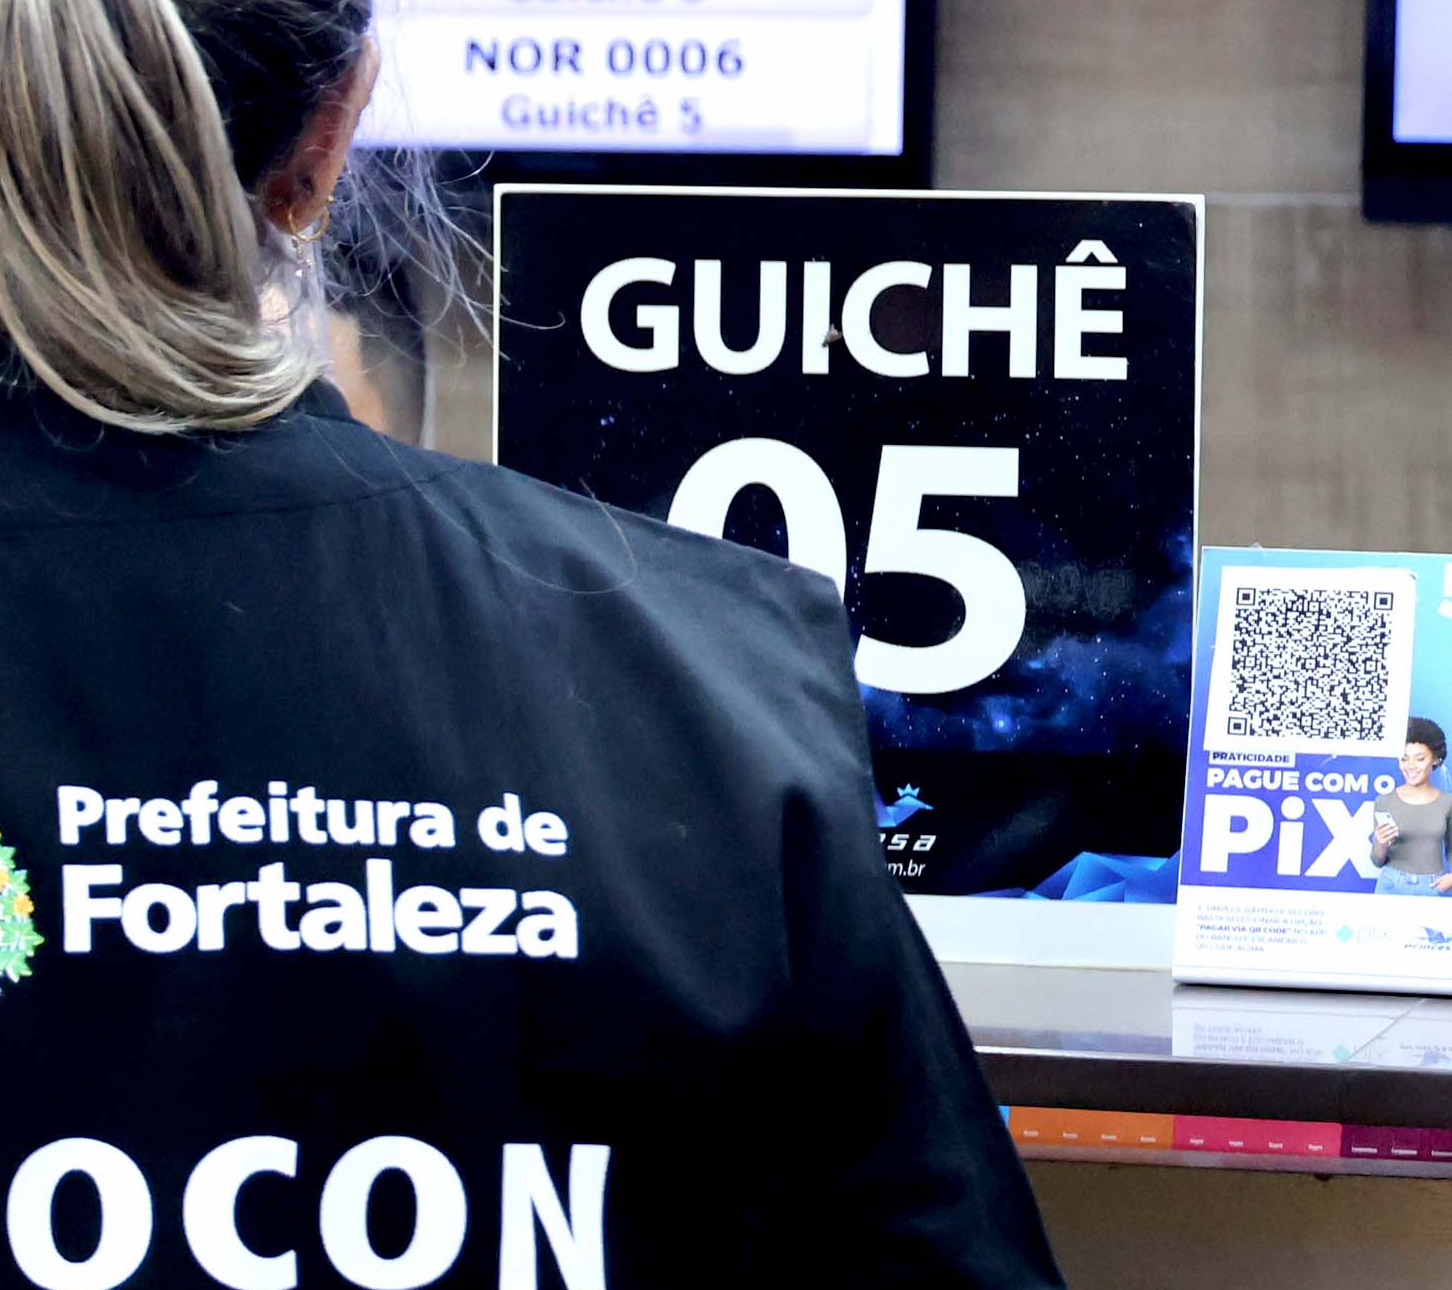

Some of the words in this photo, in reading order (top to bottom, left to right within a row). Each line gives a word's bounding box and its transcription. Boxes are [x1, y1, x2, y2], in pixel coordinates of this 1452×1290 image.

[465, 38, 582, 75] NOR
[606, 39, 745, 77] 0006
[500, 95, 659, 134] Guichê
[679, 97, 705, 135] 5
[579, 239, 1129, 381] GUICHÊ
[1211, 750, 1290, 764] PRATICIDADE
[1205, 767, 1301, 792] PAGUE
[1304, 770, 1370, 794] COM
[1373, 773, 1396, 795] O
[57, 779, 456, 850] Prefeitura
[476, 792, 570, 857] de
[61, 858, 580, 960] Fortaleza
